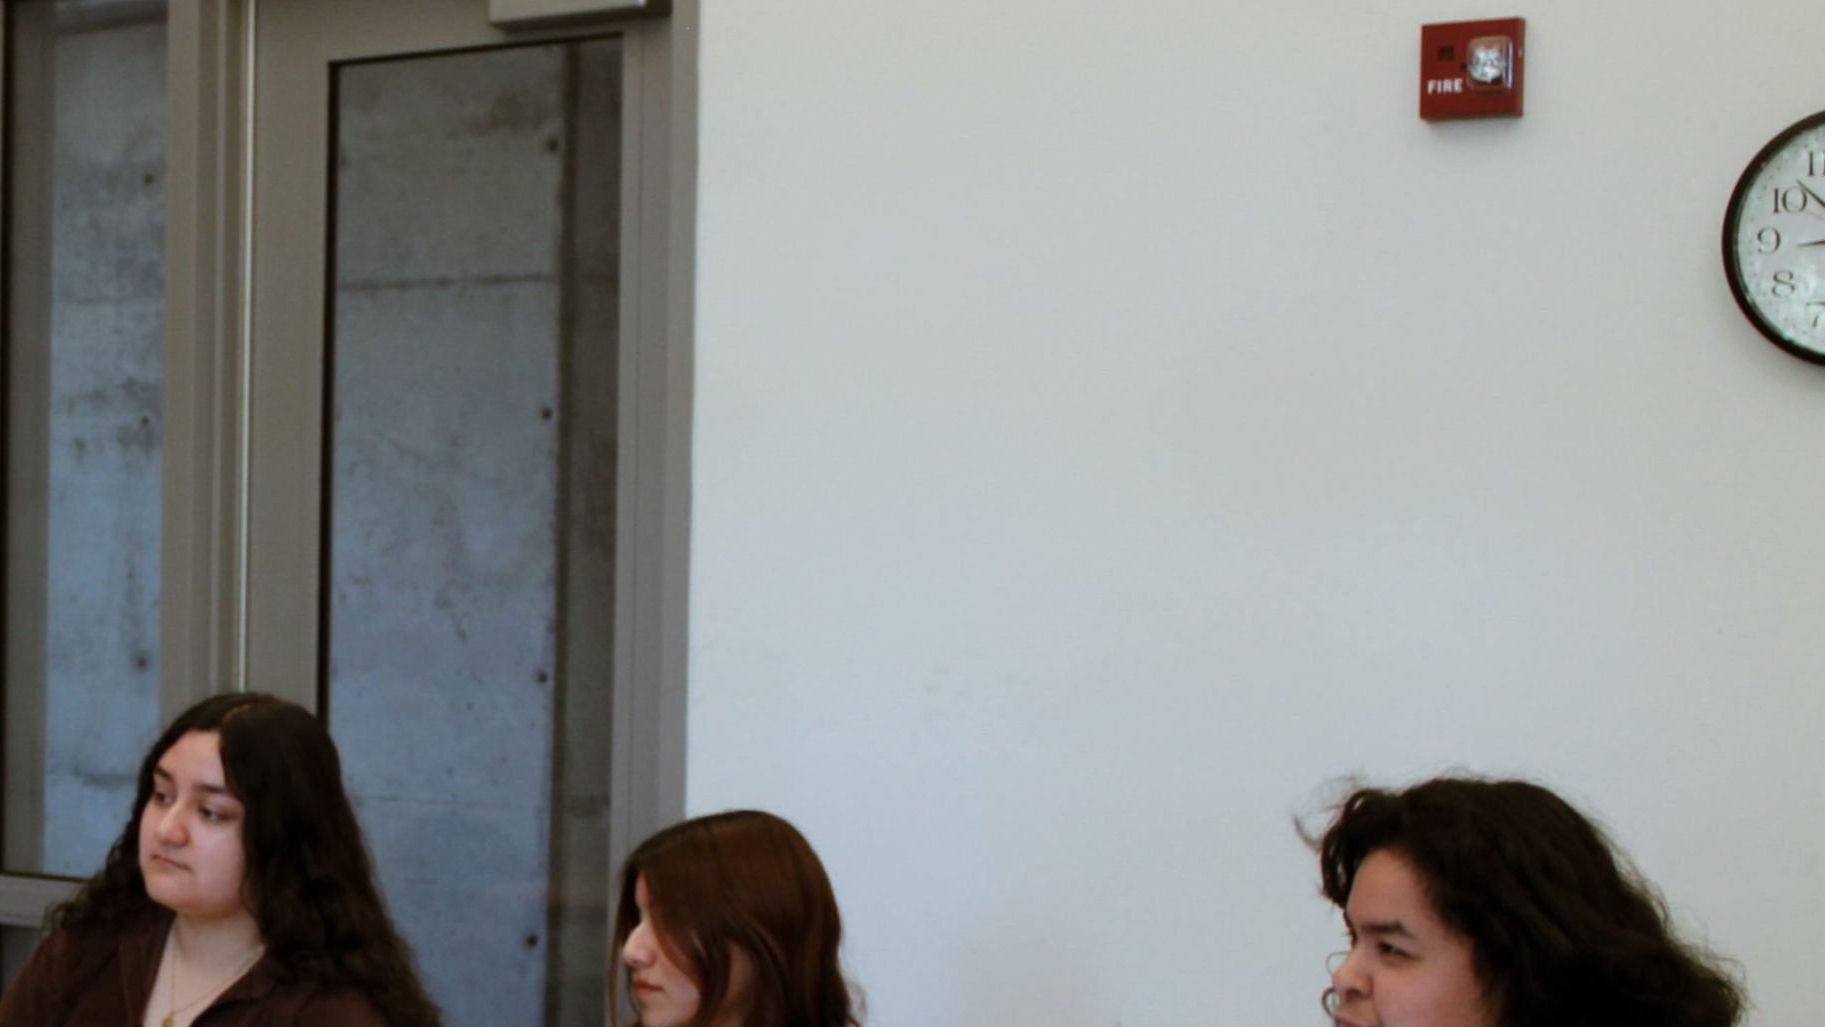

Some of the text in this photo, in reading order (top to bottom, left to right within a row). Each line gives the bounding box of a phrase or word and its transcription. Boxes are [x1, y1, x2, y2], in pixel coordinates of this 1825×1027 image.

[1427, 78, 1463, 95] FIRE
[1807, 150, 1825, 177] 1
[1773, 187, 1807, 214] 10
[1757, 227, 1782, 255] 9
[1771, 270, 1796, 298] 8
